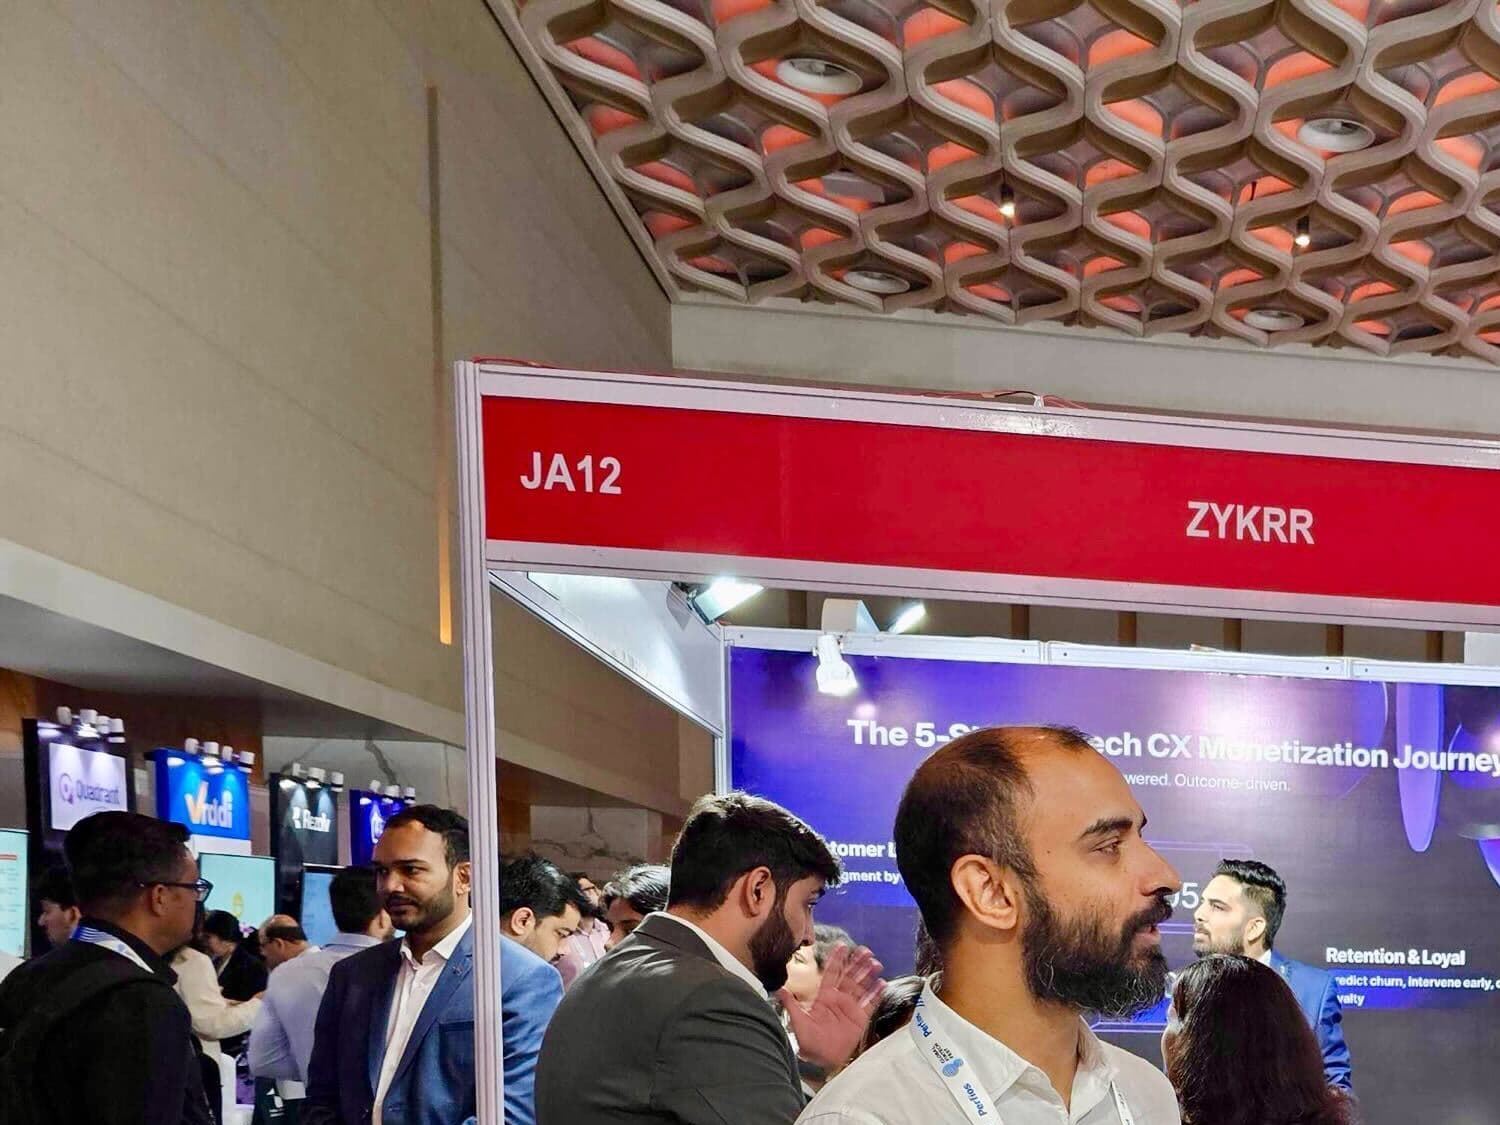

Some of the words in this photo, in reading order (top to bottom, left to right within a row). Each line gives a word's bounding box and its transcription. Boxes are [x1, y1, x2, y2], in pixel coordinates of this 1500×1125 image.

[520, 452, 622, 496] JA12
[1187, 501, 1315, 545] ZYKRR
[847, 720, 909, 747] The
[915, 722, 981, 747] 5-S
[1087, 732, 1142, 757] ech
[1148, 733, 1193, 758] CX
[1200, 736, 1387, 768] Monetization
[1125, 773, 1171, 787] wered.
[829, 841, 886, 857] tomer
[841, 871, 882, 883] gment
[884, 870, 900, 884] by
[1326, 948, 1405, 965] Retention
[1407, 950, 1420, 965] &
[1422, 950, 1466, 968] Loyal
[1370, 976, 1406, 989] churn,
[1408, 977, 1461, 989] intervene
[1463, 978, 1494, 992] early,
[1337, 993, 1365, 1006] yalty
[963, 1082, 988, 1117] Perfios
